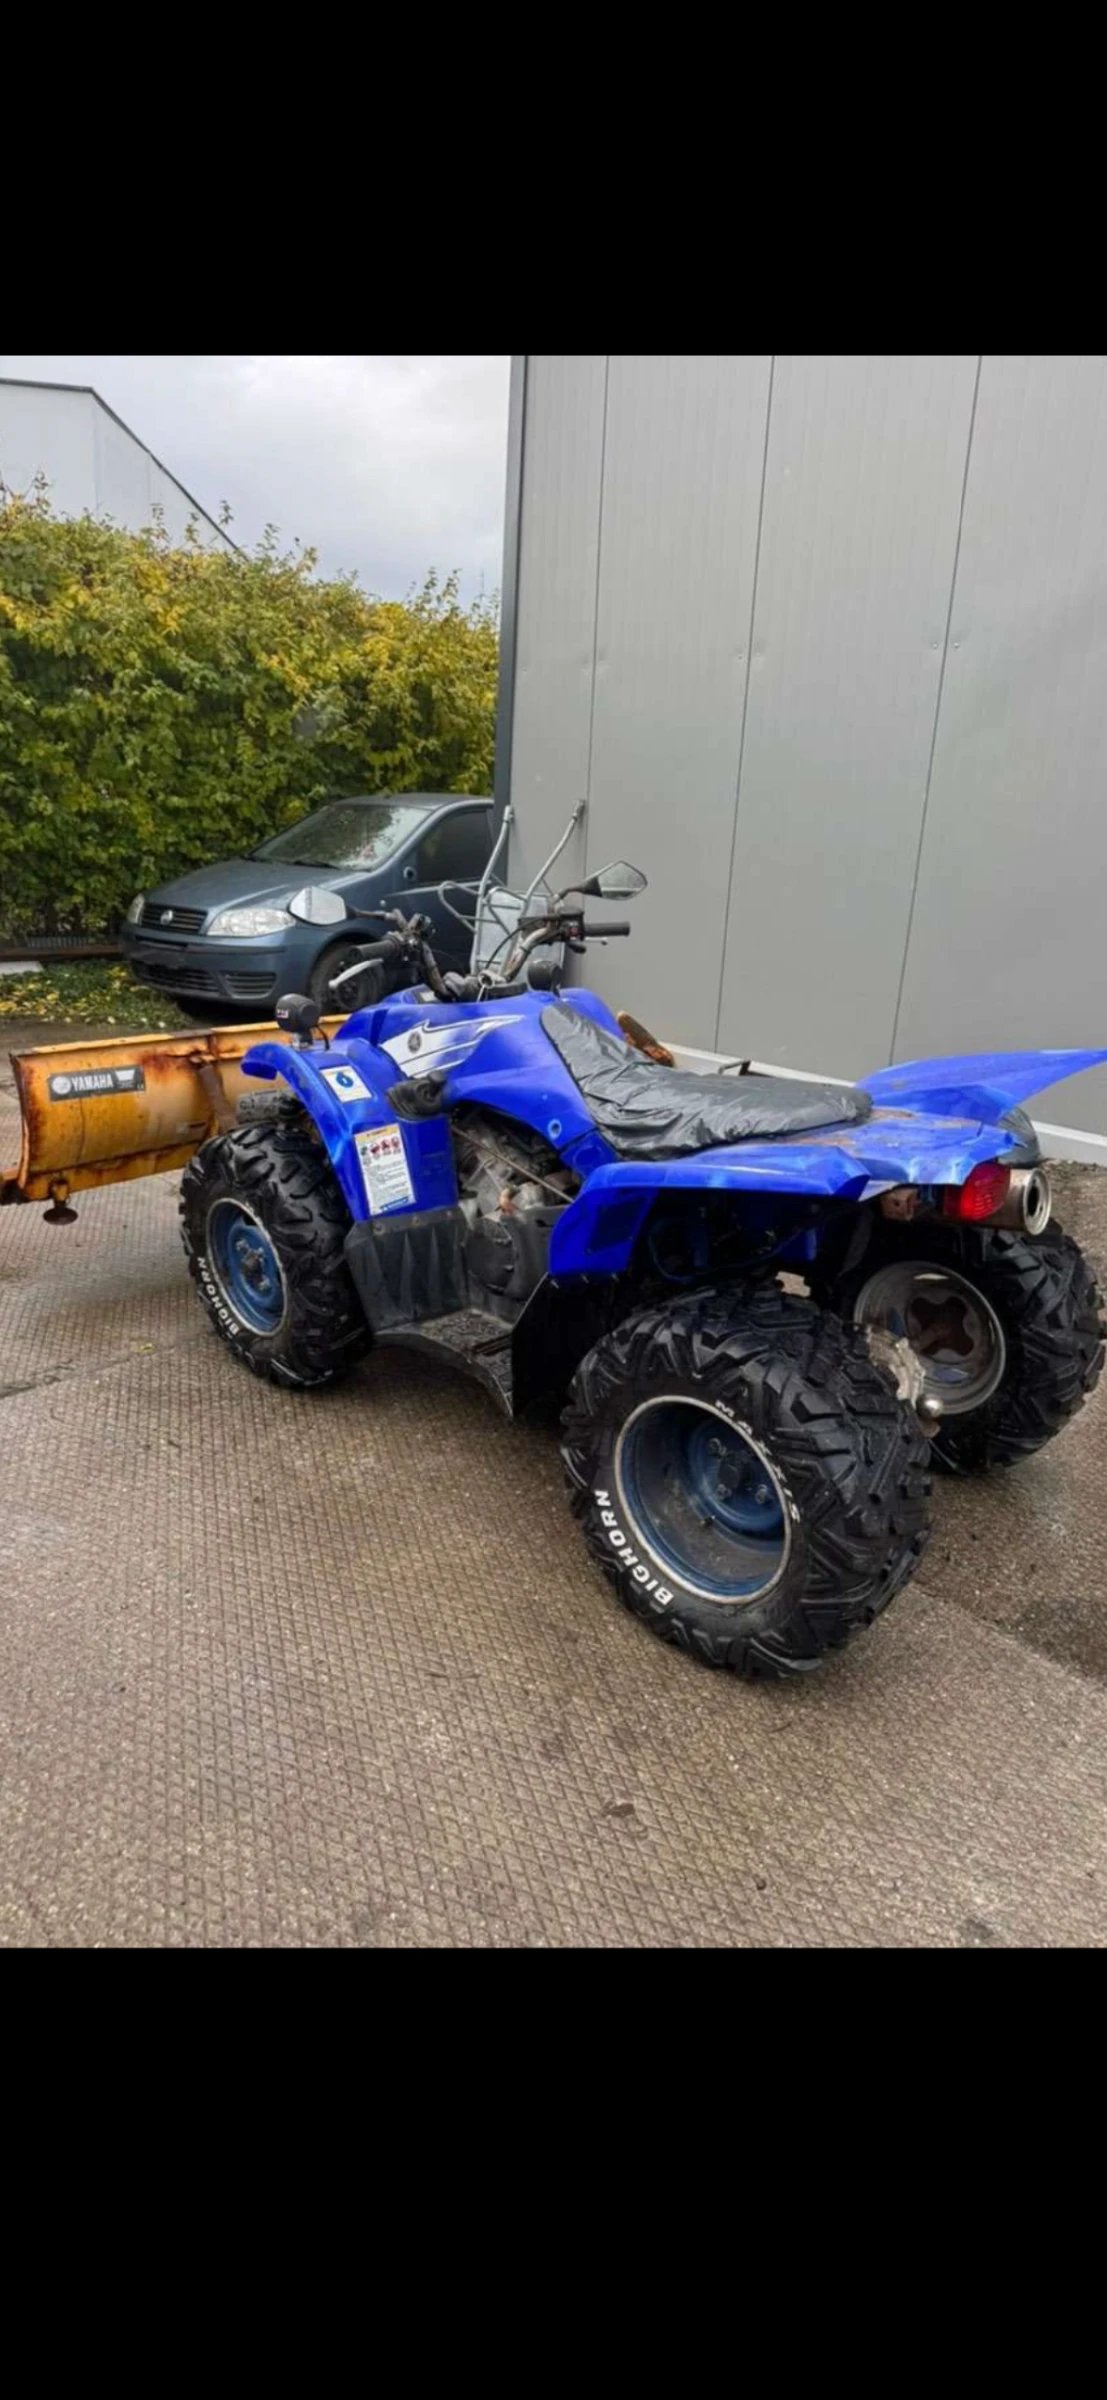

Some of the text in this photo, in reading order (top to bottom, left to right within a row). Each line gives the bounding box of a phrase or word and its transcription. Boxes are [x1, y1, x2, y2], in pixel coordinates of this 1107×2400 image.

[71, 1073, 114, 1092] YAMAHA
[197, 1257, 240, 1335] BIGHORN
[715, 1400, 801, 1523] MAXXIS
[594, 1490, 674, 1605] BIGHORN
